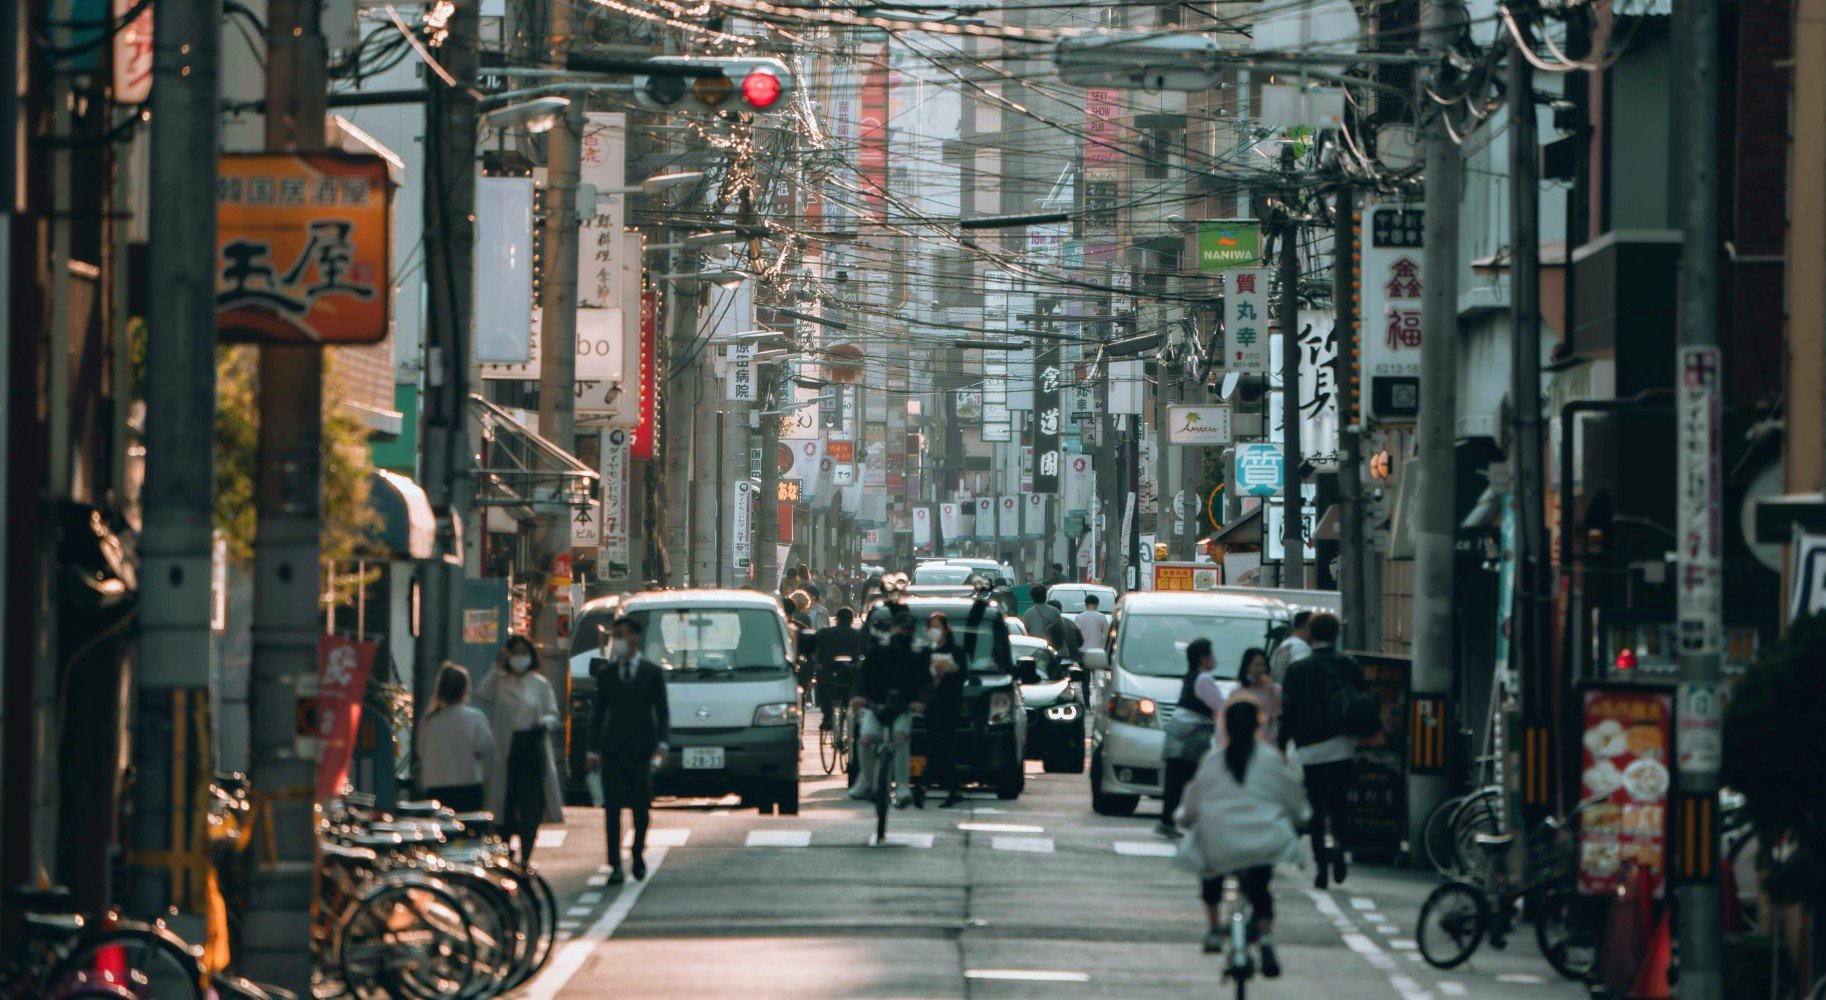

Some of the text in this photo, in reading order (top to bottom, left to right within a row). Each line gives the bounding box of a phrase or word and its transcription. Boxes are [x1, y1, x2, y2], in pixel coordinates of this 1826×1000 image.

[1091, 91, 1108, 101] SEXY
[1203, 250, 1253, 260] NANIWA
[1236, 273, 1257, 348] 質丸幸
[1241, 450, 1284, 490] 質
[576, 529, 596, 540] ビル
